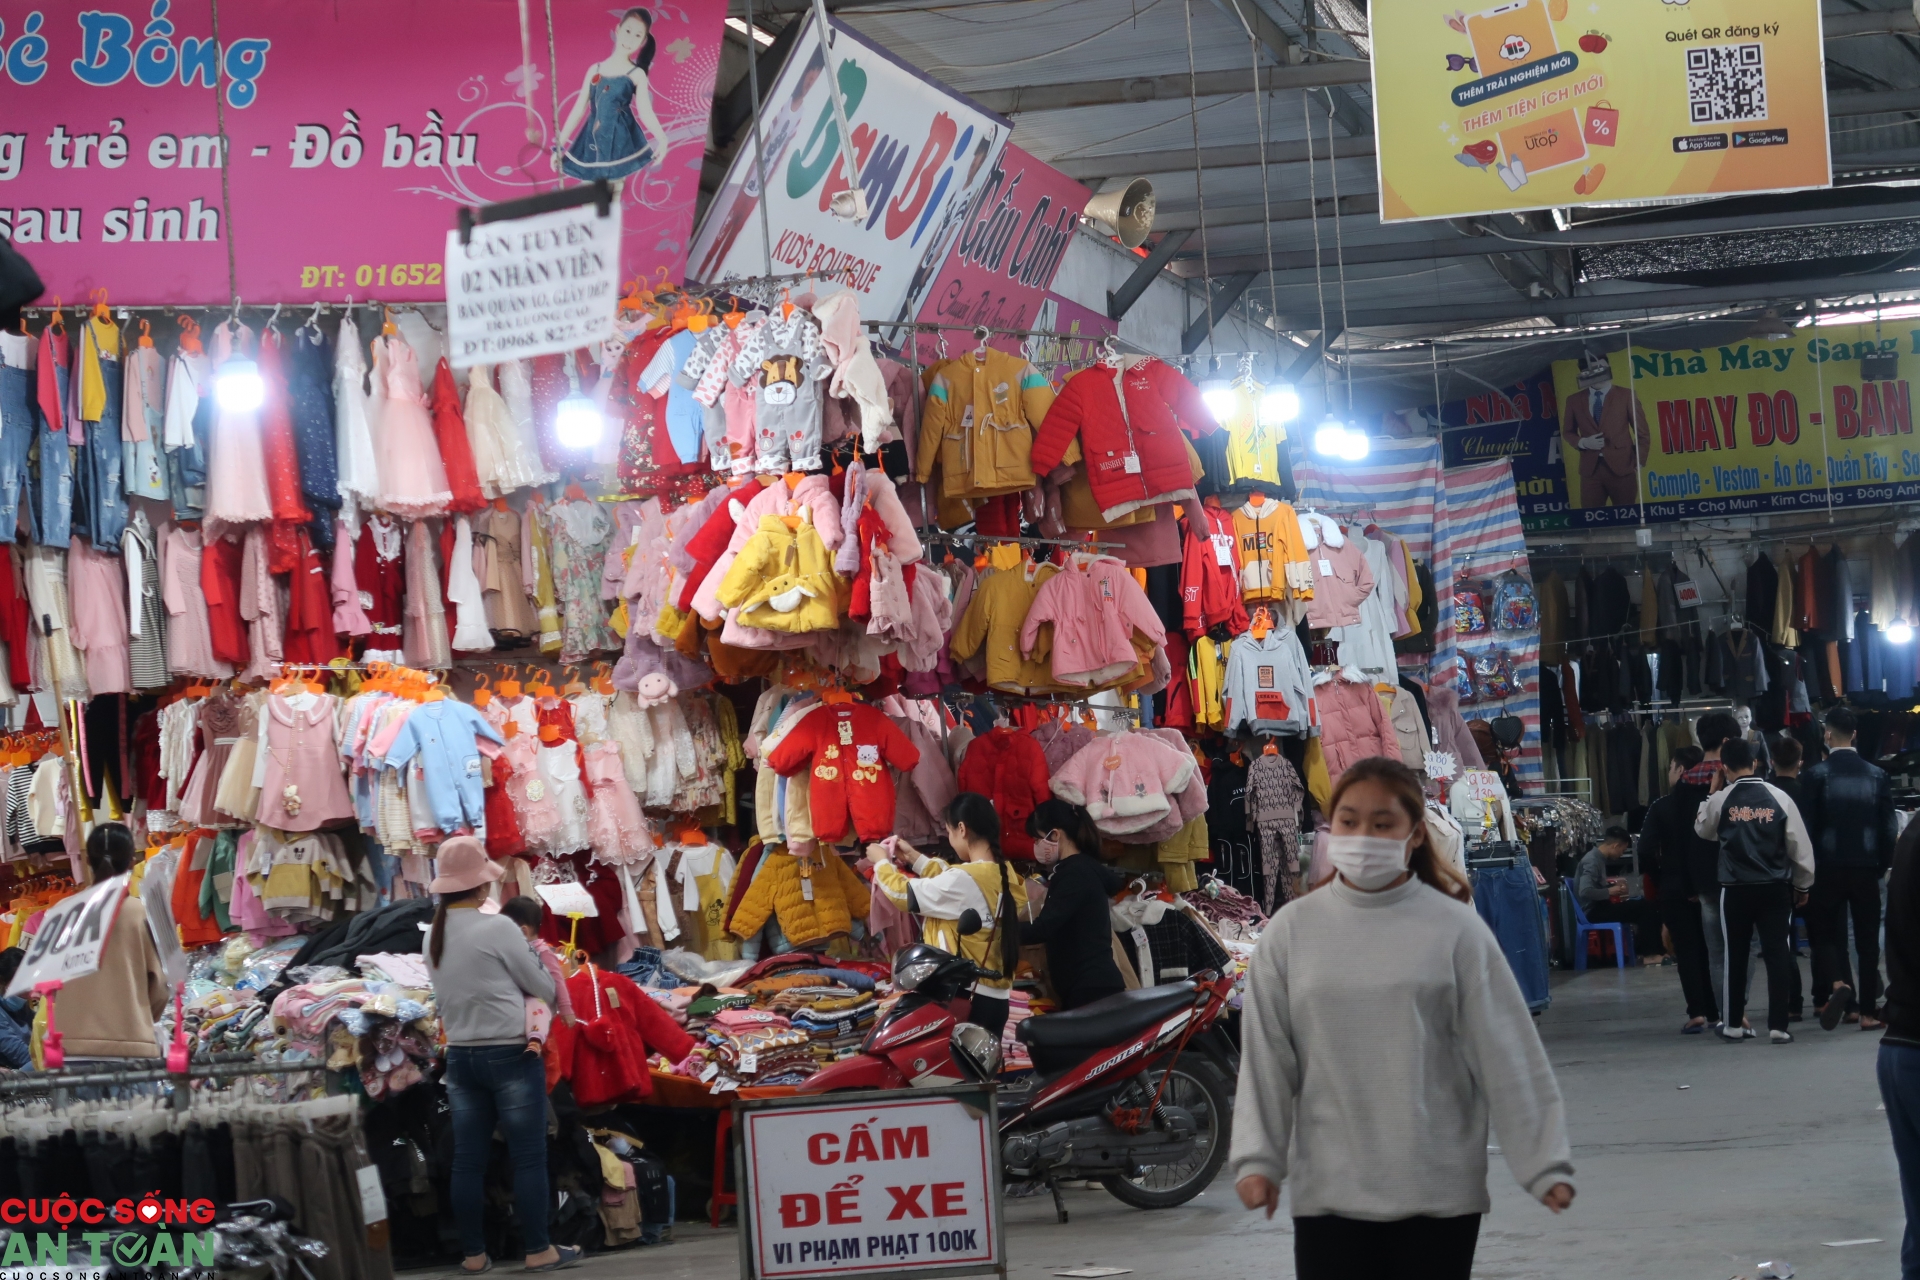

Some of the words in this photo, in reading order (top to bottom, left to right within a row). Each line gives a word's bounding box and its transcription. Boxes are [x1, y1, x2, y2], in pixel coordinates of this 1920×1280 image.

[0, 11, 48, 85] é
[1665, 29, 1698, 42] Quét
[1702, 27, 1721, 39] QR
[1725, 25, 1760, 38] đăng
[1764, 21, 1780, 36] ký
[1458, 84, 1484, 101] THÊM
[1486, 77, 1508, 93] TRẢI
[1510, 64, 1549, 84] NGHIỆM
[1551, 57, 1571, 71] MỚI
[1463, 109, 1503, 133] THÊM
[1506, 97, 1537, 118] TIỆN
[1541, 87, 1569, 107] ÍCH
[1573, 73, 1604, 96] MỚI
[45, 118, 129, 169] trẻ
[148, 133, 229, 169] em
[289, 109, 364, 168] Đồ
[382, 109, 478, 167] bầu
[1689, 141, 1703, 150] App
[1703, 140, 1721, 148] Store
[1749, 136, 1773, 144] Google
[1773, 135, 1785, 143] Play
[102, 197, 220, 242] sinh
[771, 228, 814, 269] KID'S
[301, 266, 345, 288] ĐT:
[355, 263, 442, 287] 01652
[461, 270, 483, 295] 02
[488, 256, 551, 290] NHÂN
[1631, 348, 1708, 380] Nhà
[1717, 344, 1796, 373] May
[1466, 382, 1533, 425] Nhà
[1657, 394, 1737, 454] MAY
[1747, 388, 1799, 446] ĐO
[1648, 469, 1701, 498] Comple
[1713, 464, 1760, 493] Veston
[1774, 455, 1792, 487] Áo
[1795, 458, 1813, 485] da
[1827, 449, 1861, 485] Quần
[1863, 451, 1888, 483] Tây
[1584, 510, 1609, 523] ĐC:
[1613, 507, 1638, 520] 12A
[1650, 502, 1675, 517] Khu
[1678, 503, 1686, 515] E
[1698, 499, 1726, 515] Chợ
[1771, 493, 1796, 507] Kim
[1799, 489, 1844, 506] Chung
[1856, 485, 1892, 501] Đông
[1084, 1040, 1144, 1081] JUPITER
[807, 1116, 930, 1166] CẤM
[778, 1174, 866, 1229] ĐỂ
[884, 1181, 968, 1221] XE
[773, 1242, 793, 1265] VI
[799, 1236, 861, 1266] PHẠM
[866, 1233, 920, 1261] PHẠT
[926, 1229, 978, 1254] 100K
